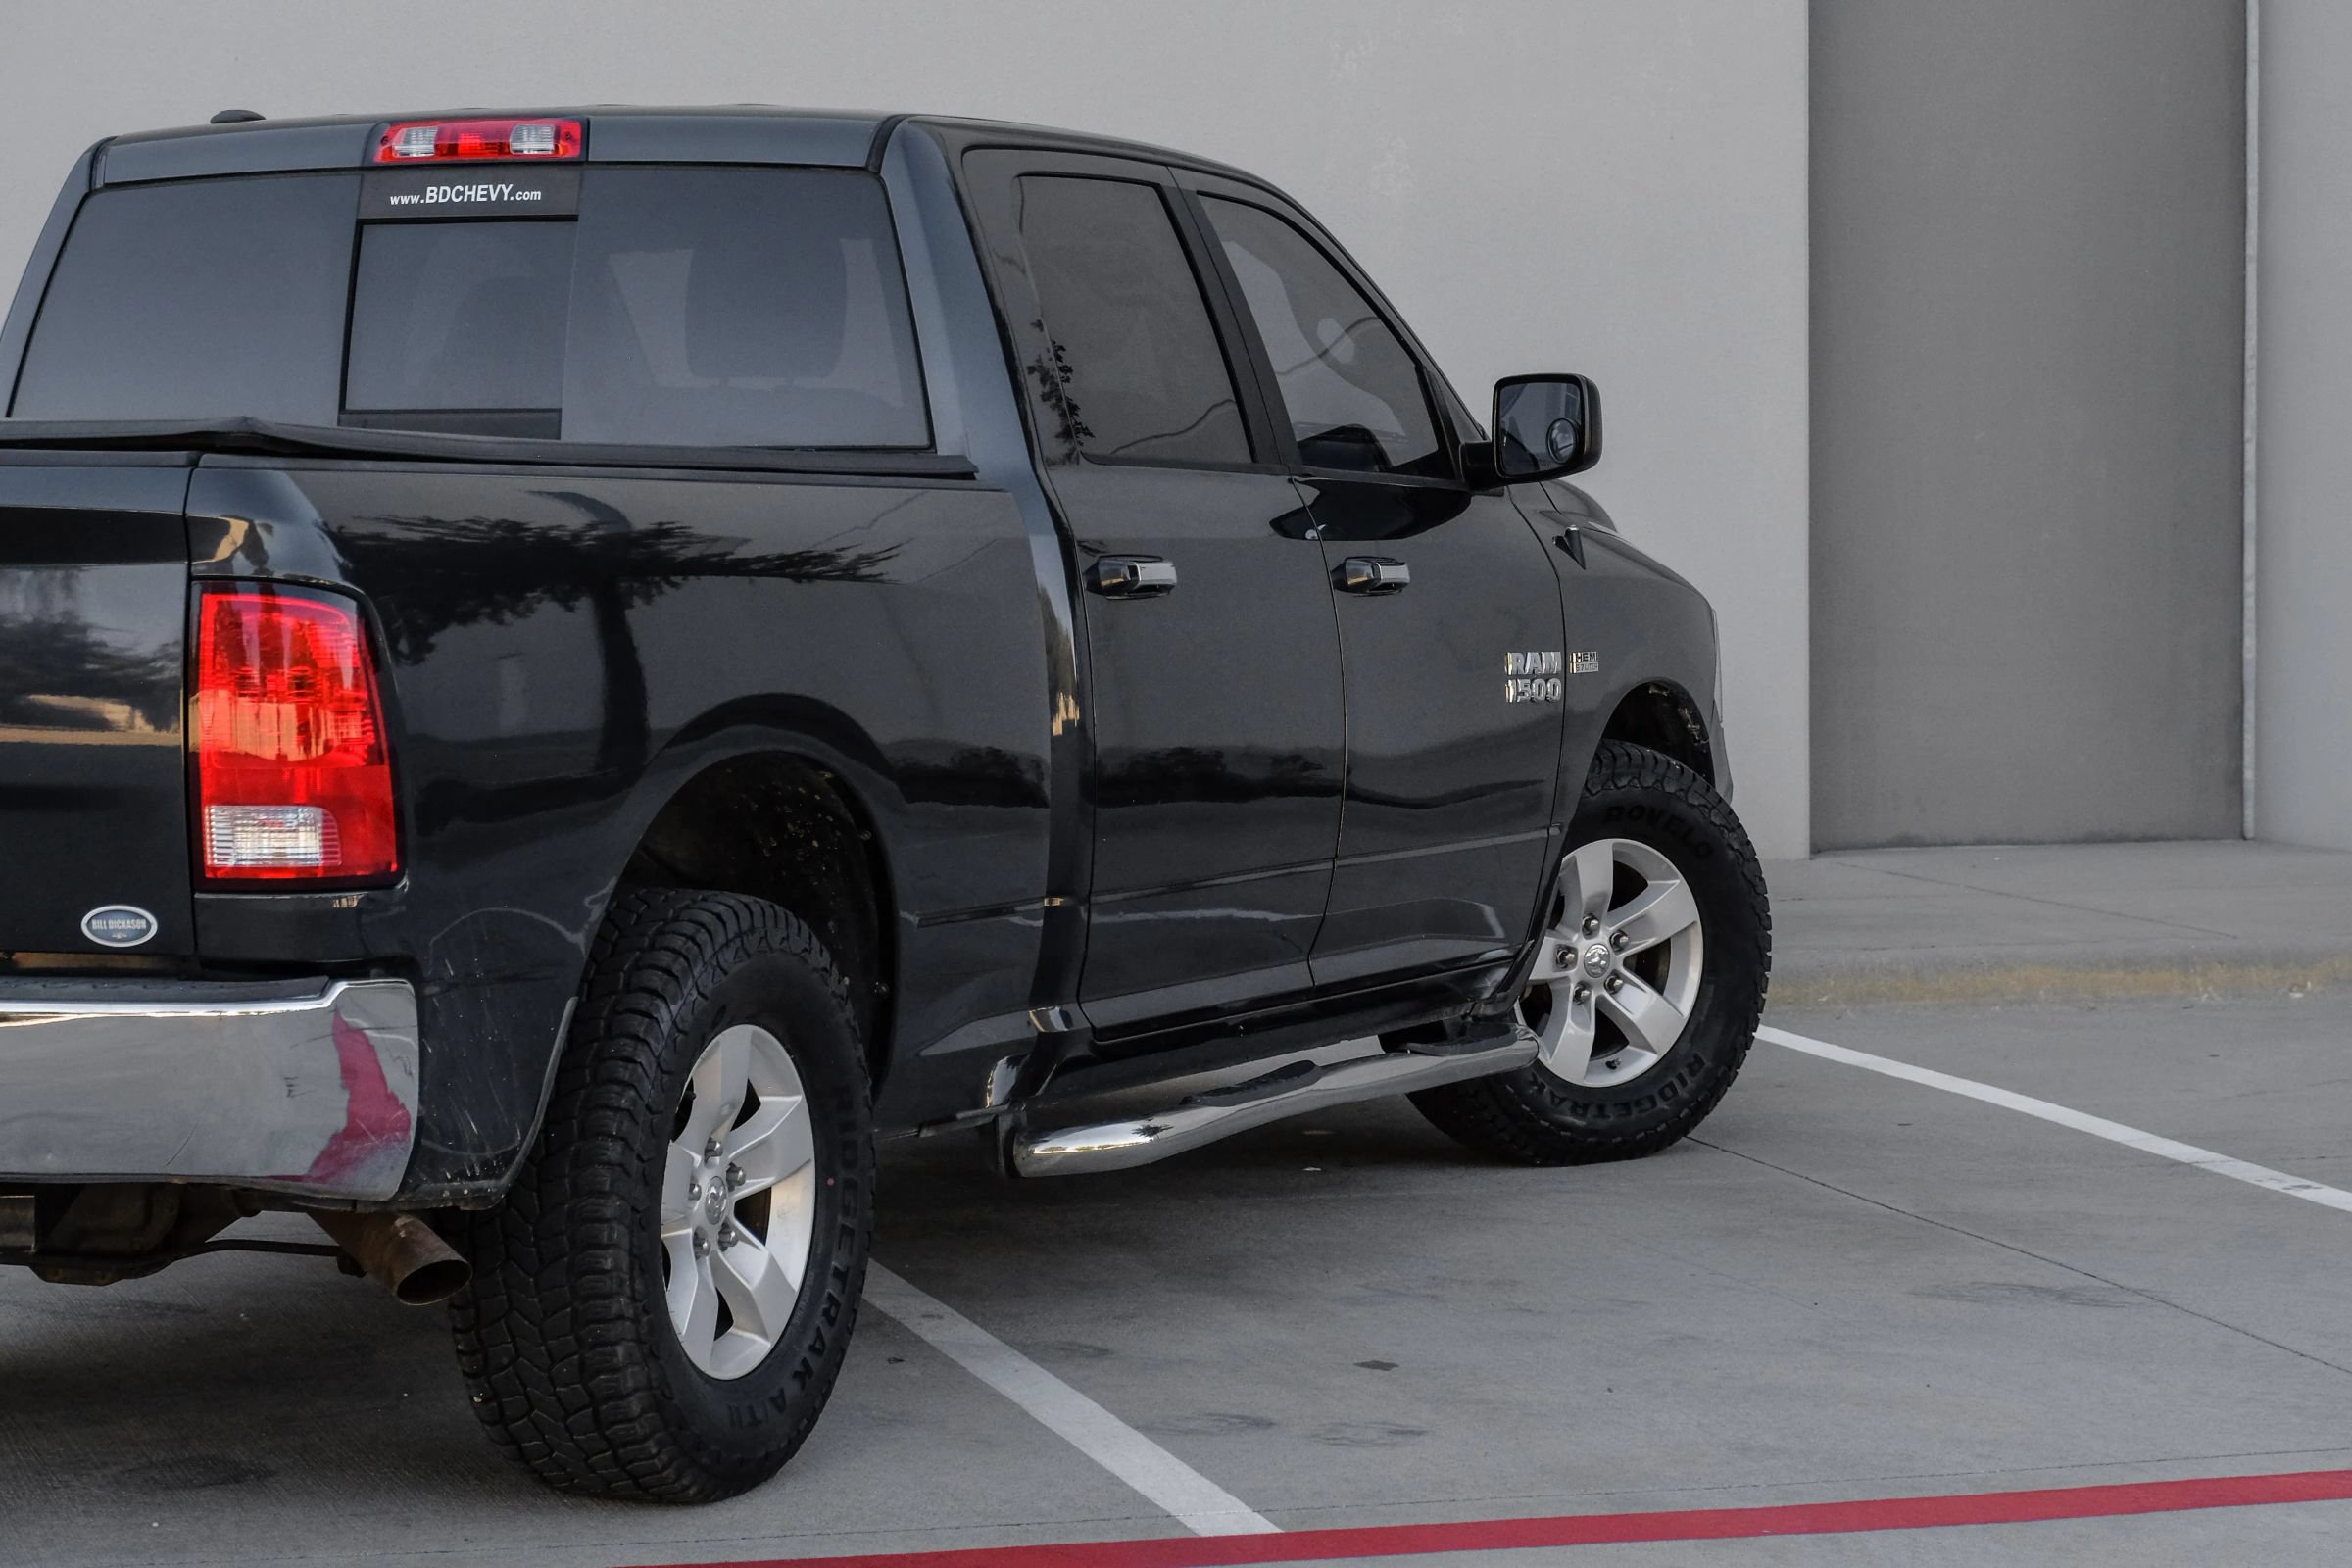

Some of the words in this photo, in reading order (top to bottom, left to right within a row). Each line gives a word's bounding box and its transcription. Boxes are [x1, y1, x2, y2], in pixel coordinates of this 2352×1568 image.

[390, 184, 541, 205] www.BDCHEVY.com
[1505, 651, 1561, 674] RAM
[1505, 677, 1561, 703] 1500
[1601, 804, 1715, 860] ROVELO
[91, 918, 107, 930] BILL
[1529, 1052, 1706, 1120] RIDGETRAK
[791, 1084, 859, 1392] RIDGETRAK
